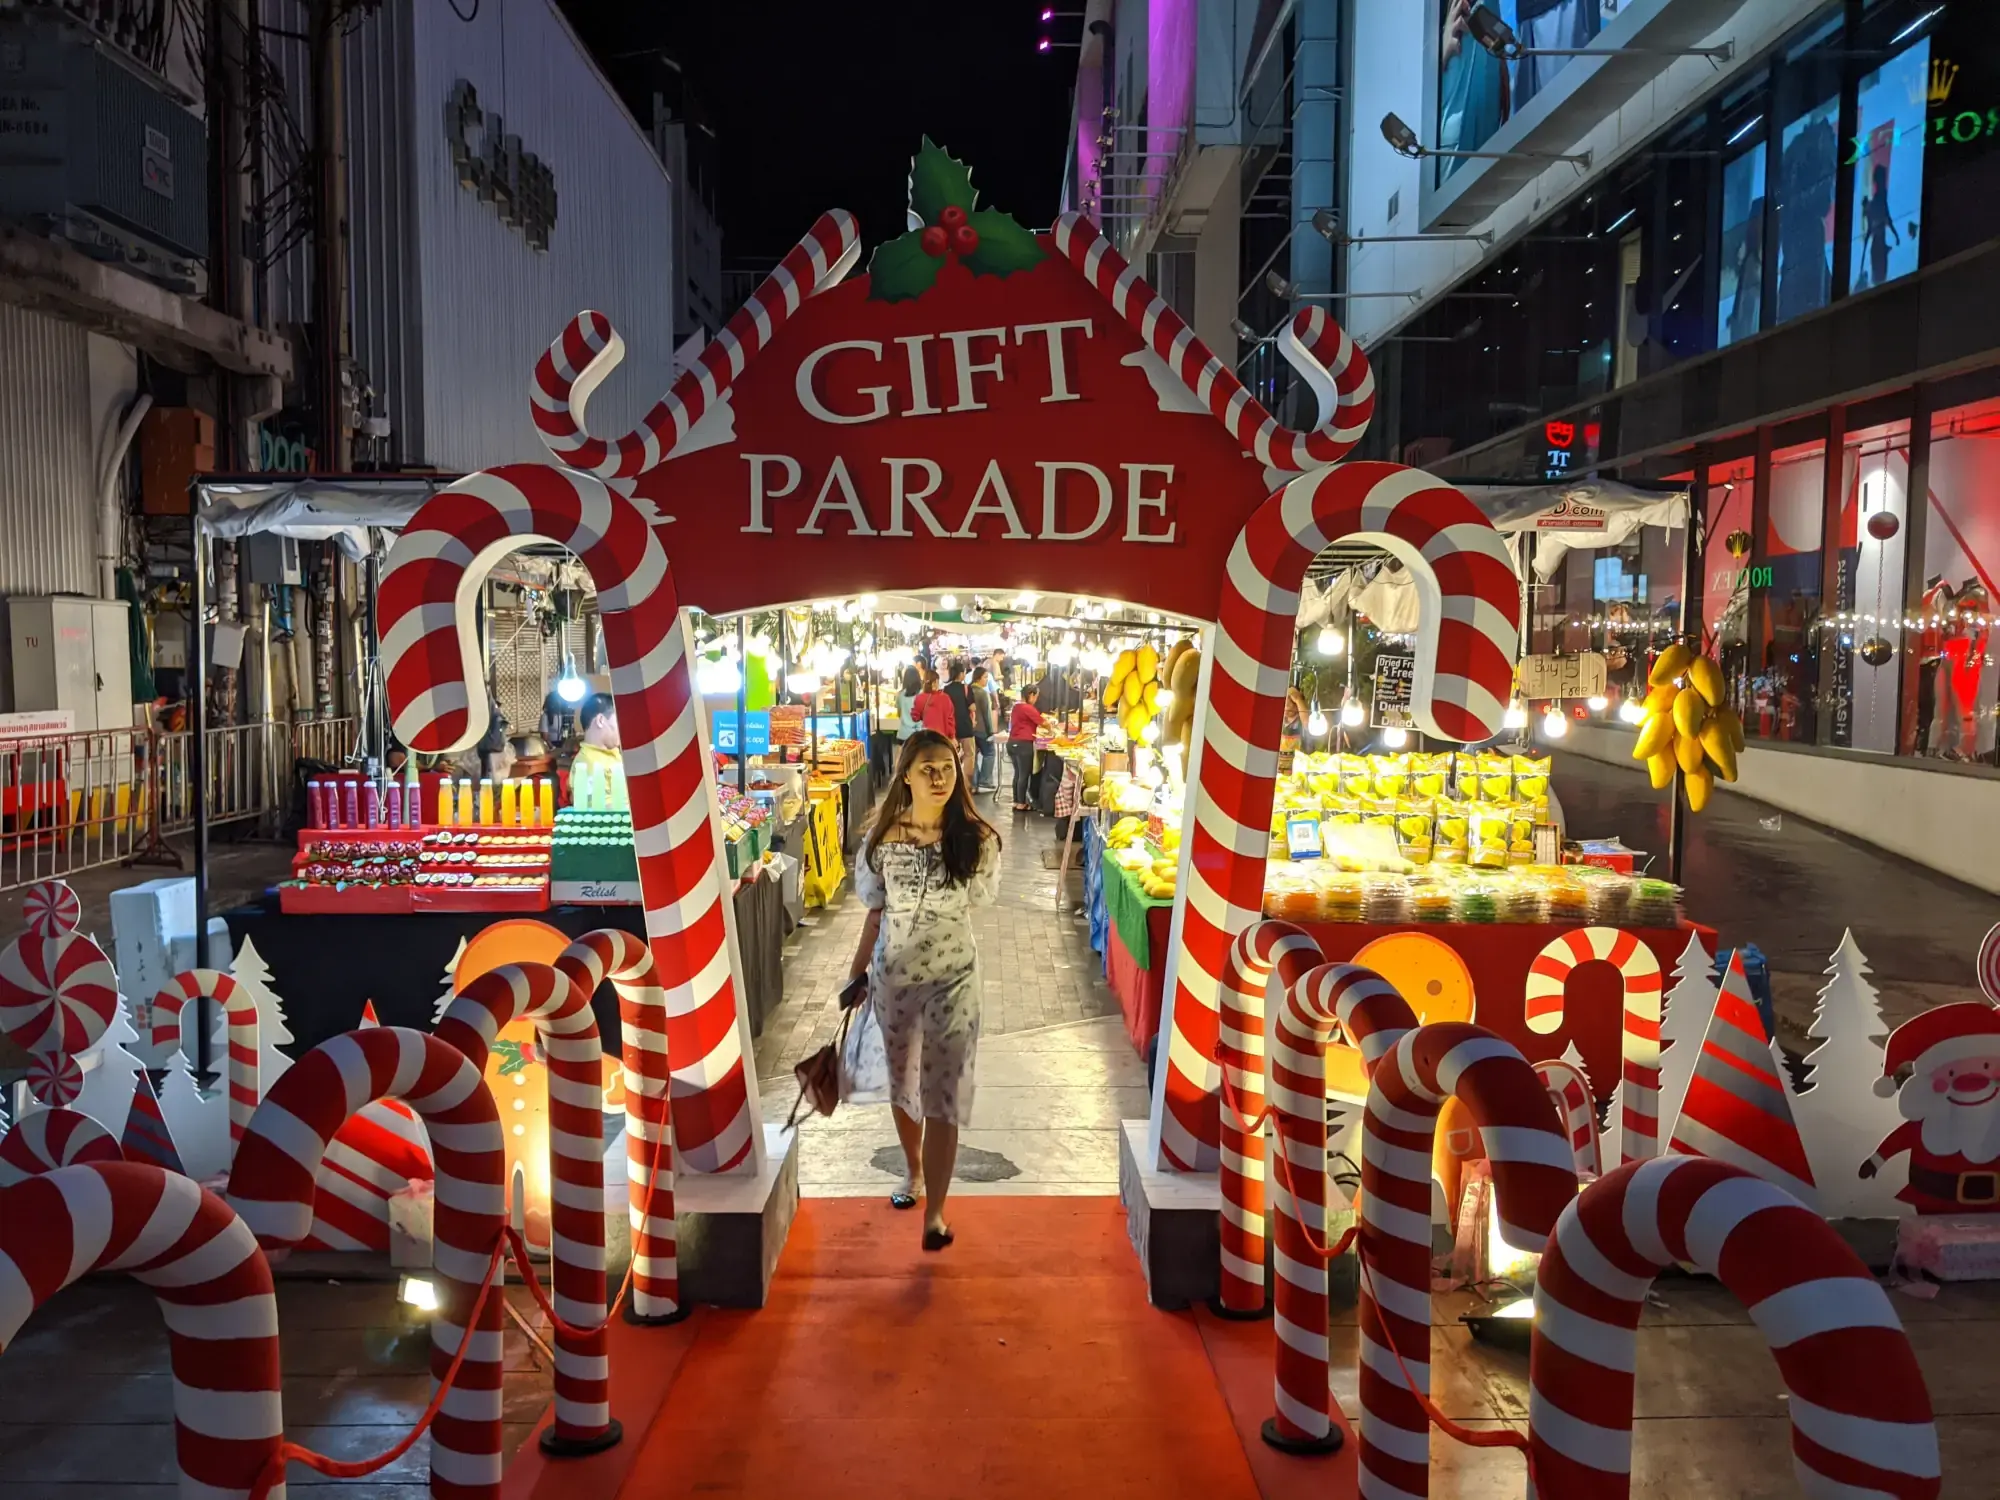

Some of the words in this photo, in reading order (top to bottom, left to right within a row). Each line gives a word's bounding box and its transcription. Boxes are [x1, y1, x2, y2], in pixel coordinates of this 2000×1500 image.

[795, 319, 1093, 424] GIFT
[739, 453, 1176, 543] PARADE
[25, 636, 38, 648] TU
[1379, 658, 1401, 669] Dried
[1535, 659, 1558, 677] Buy
[1565, 658, 1579, 678] 5
[1391, 668, 1413, 678] Free
[580, 885, 617, 898] Relish
